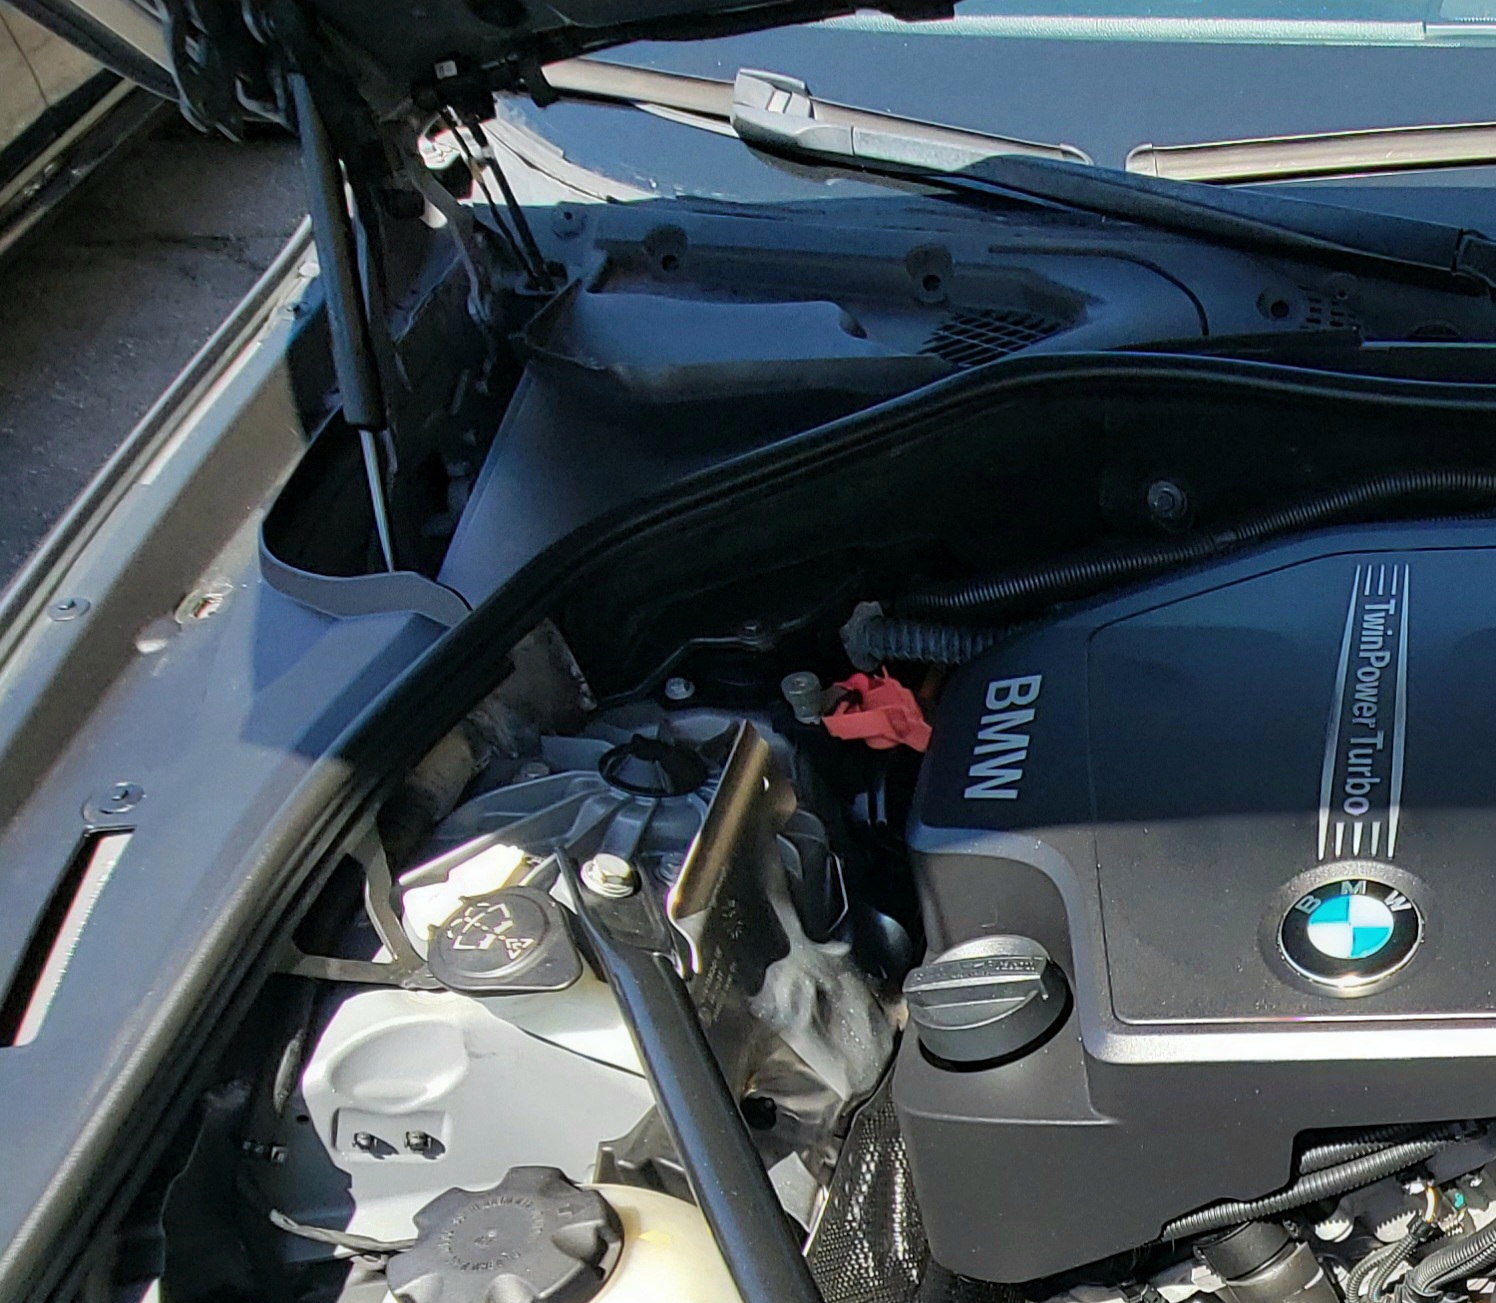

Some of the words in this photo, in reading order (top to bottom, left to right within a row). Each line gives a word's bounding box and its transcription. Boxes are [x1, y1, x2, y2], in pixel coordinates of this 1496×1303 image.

[1352, 599, 1395, 728] TwinPower
[963, 673, 1042, 800] BMW
[1343, 730, 1384, 816] Turbo
[1295, 880, 1412, 914] BMW
